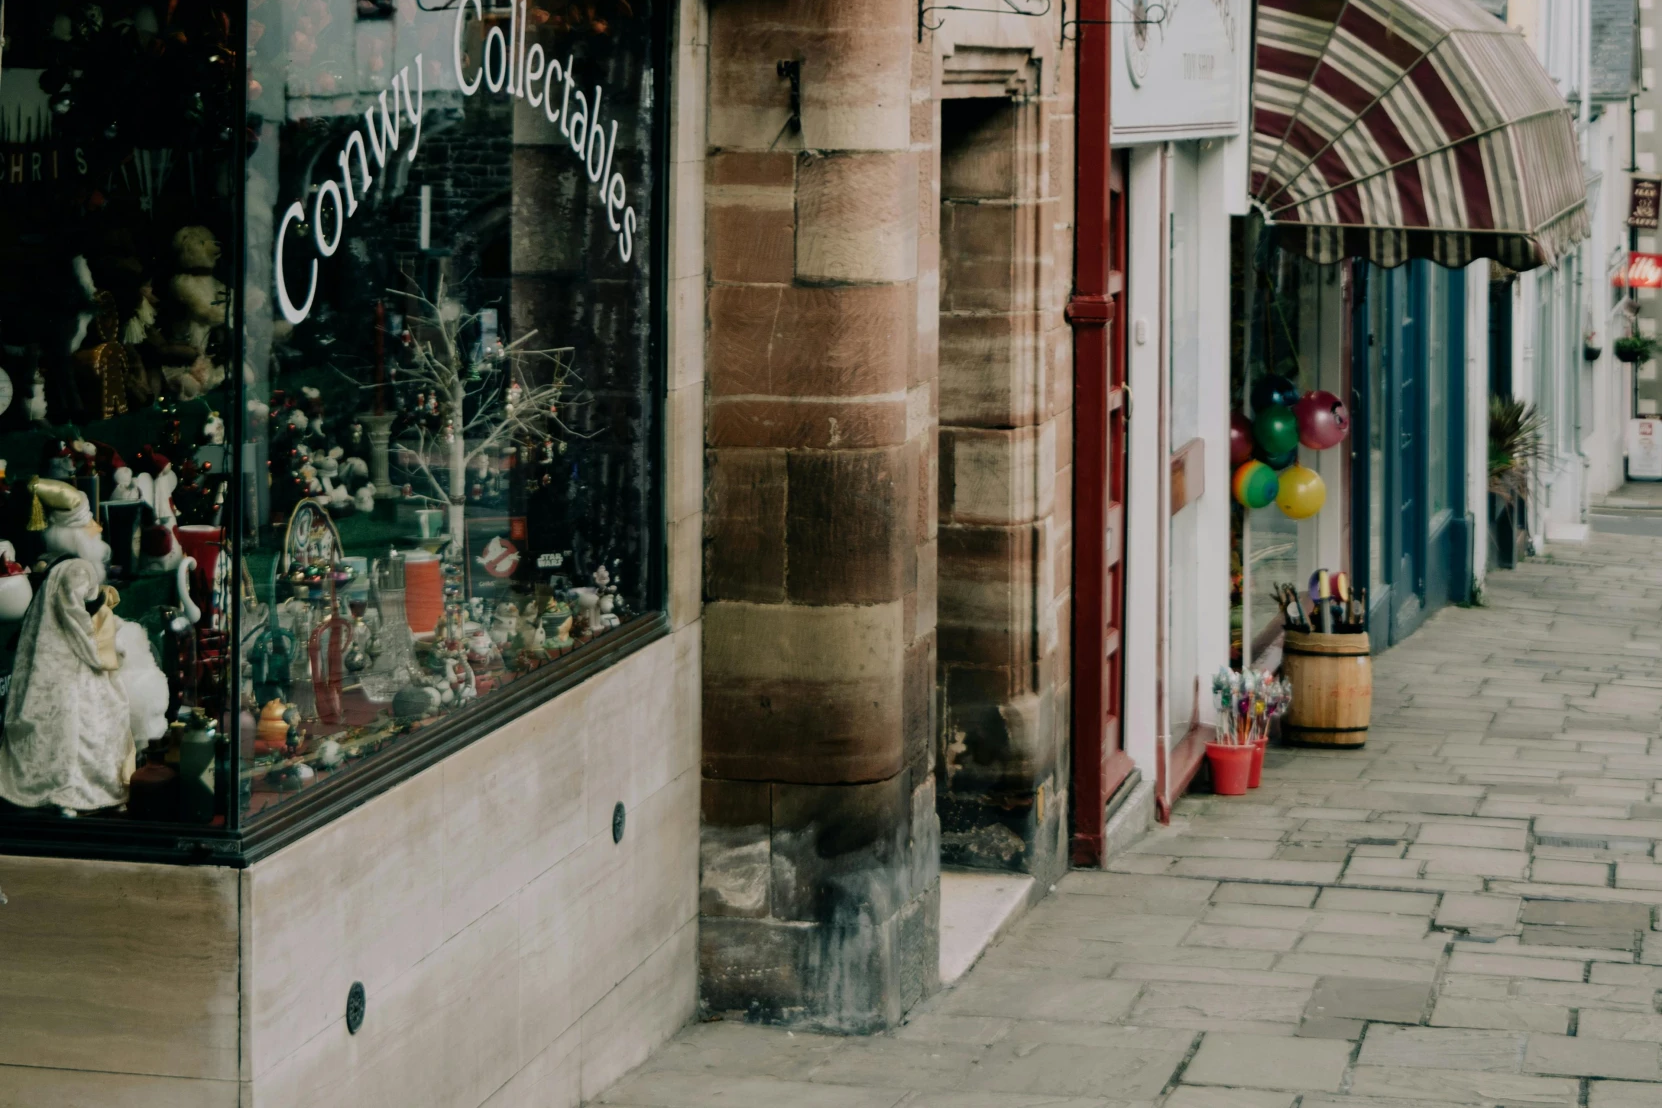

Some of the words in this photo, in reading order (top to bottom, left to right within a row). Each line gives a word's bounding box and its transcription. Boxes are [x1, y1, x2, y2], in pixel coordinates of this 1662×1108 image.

[274, 54, 424, 324] Conwy
[540, 552, 563, 560] STAR
[537, 559, 563, 567] WARS
